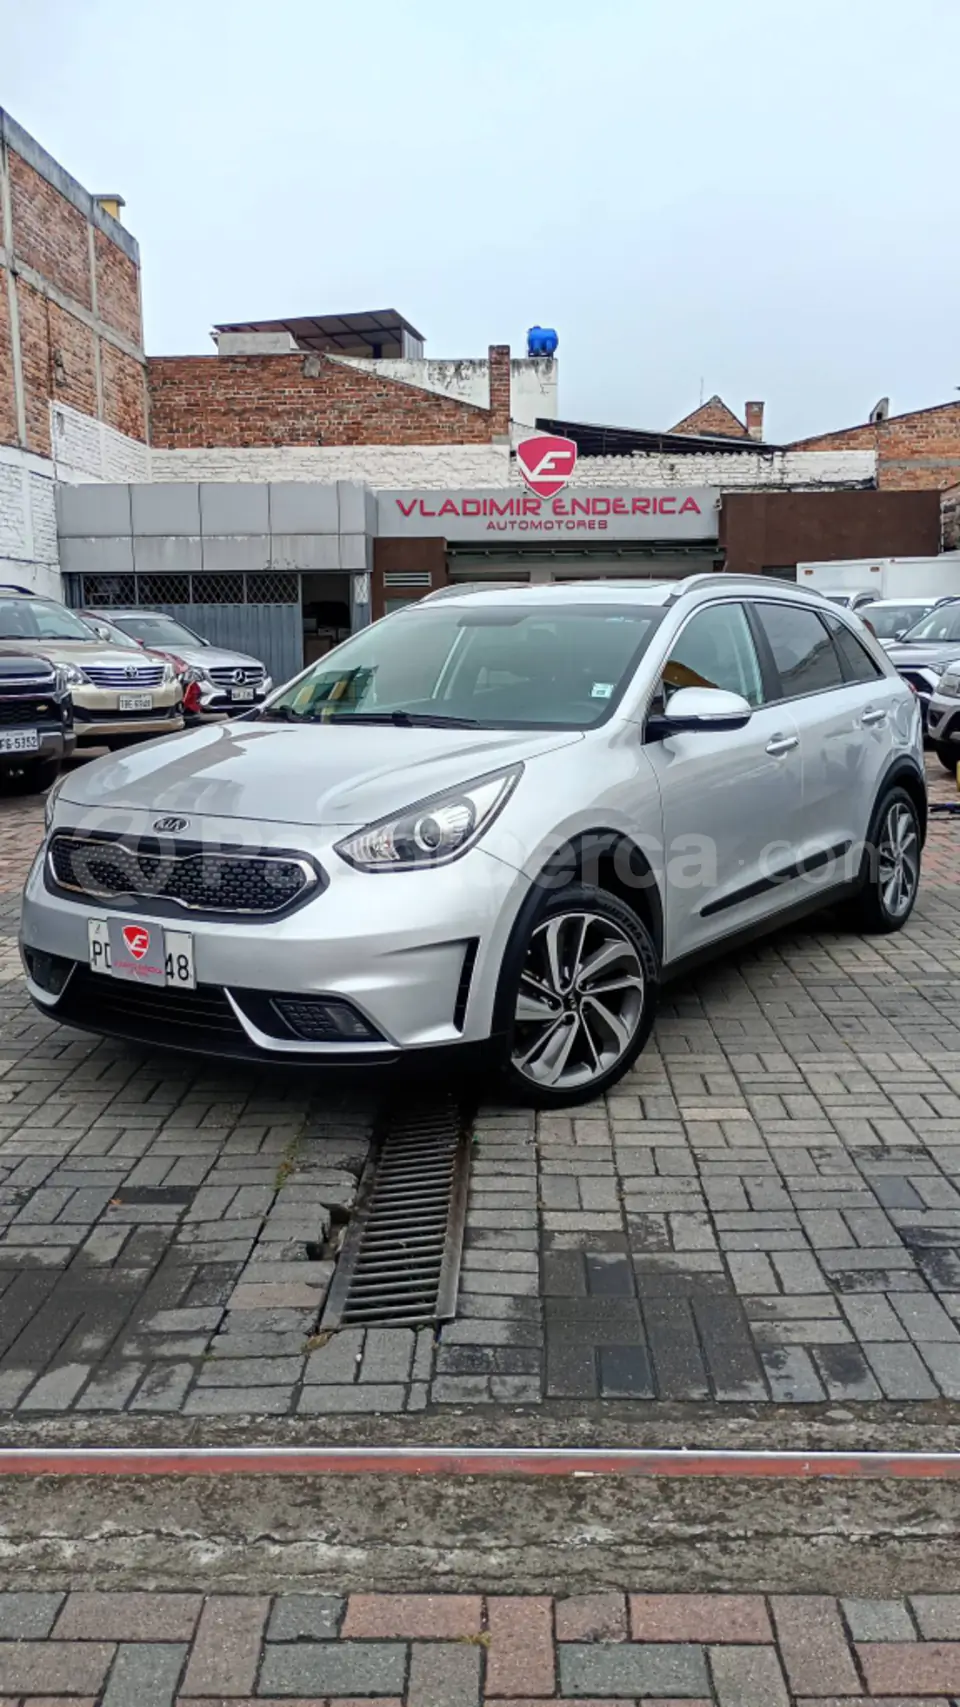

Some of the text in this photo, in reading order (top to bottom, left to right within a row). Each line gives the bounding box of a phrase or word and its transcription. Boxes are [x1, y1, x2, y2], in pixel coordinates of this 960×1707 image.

[396, 496, 701, 516] VLADIMIR ENDERICA
[486, 519, 608, 531] AUTOMOTORES
